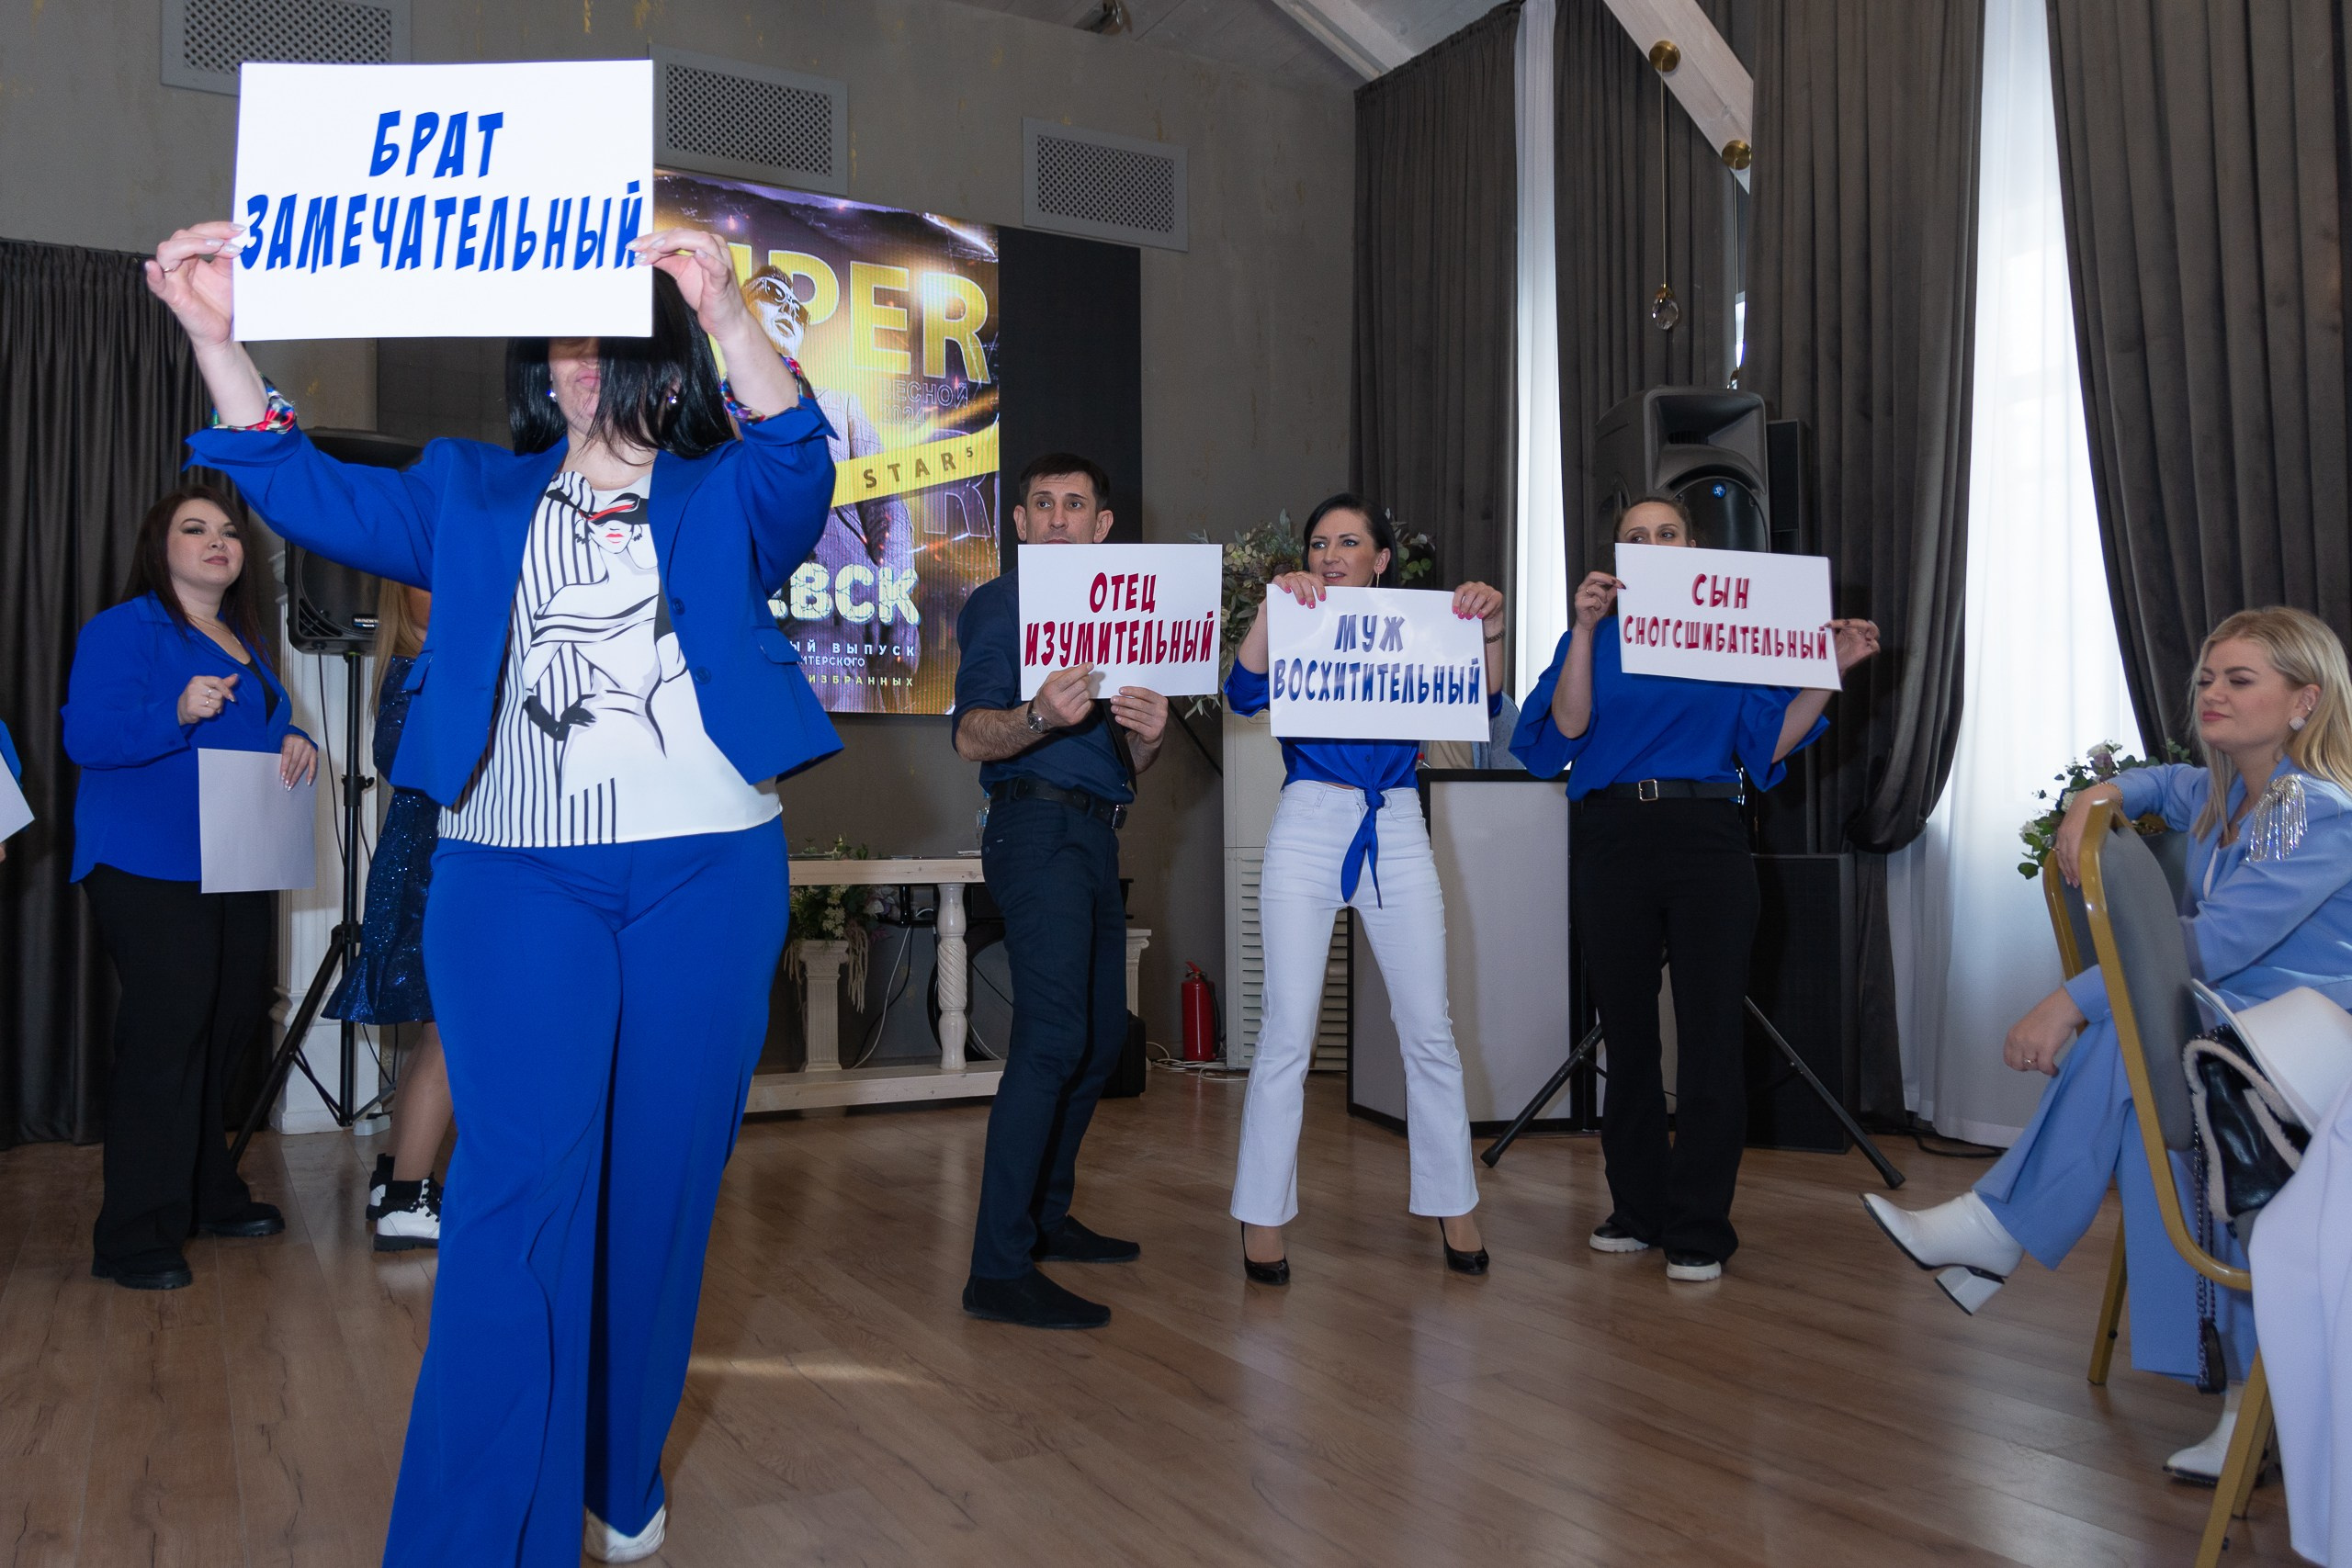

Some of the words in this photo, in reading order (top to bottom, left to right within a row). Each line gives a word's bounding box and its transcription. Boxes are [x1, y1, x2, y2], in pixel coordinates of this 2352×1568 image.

[369, 110, 504, 178] БРАТ
[240, 180, 643, 275] ЗАМЕЧАТЕЛЬНЫЙ
[884, 378, 968, 408] ВЕСНОЙ
[767, 562, 921, 626] ВСК
[1089, 572, 1157, 614] ОТЕЦ
[1691, 573, 1750, 609] СЫН
[832, 642, 915, 656] ВЫПУСК
[1024, 610, 1215, 668] ИЗУМИТЕЛЬНЫЙ
[1334, 614, 1406, 653] МУЖ
[1623, 615, 1827, 660] СНОГСШИБАТЕЛЬНЫЙ
[808, 674, 913, 687] ИЗБРАННЫХ
[1273, 657, 1480, 705] ВОСХИТИТЕЛЬНЫЙ
